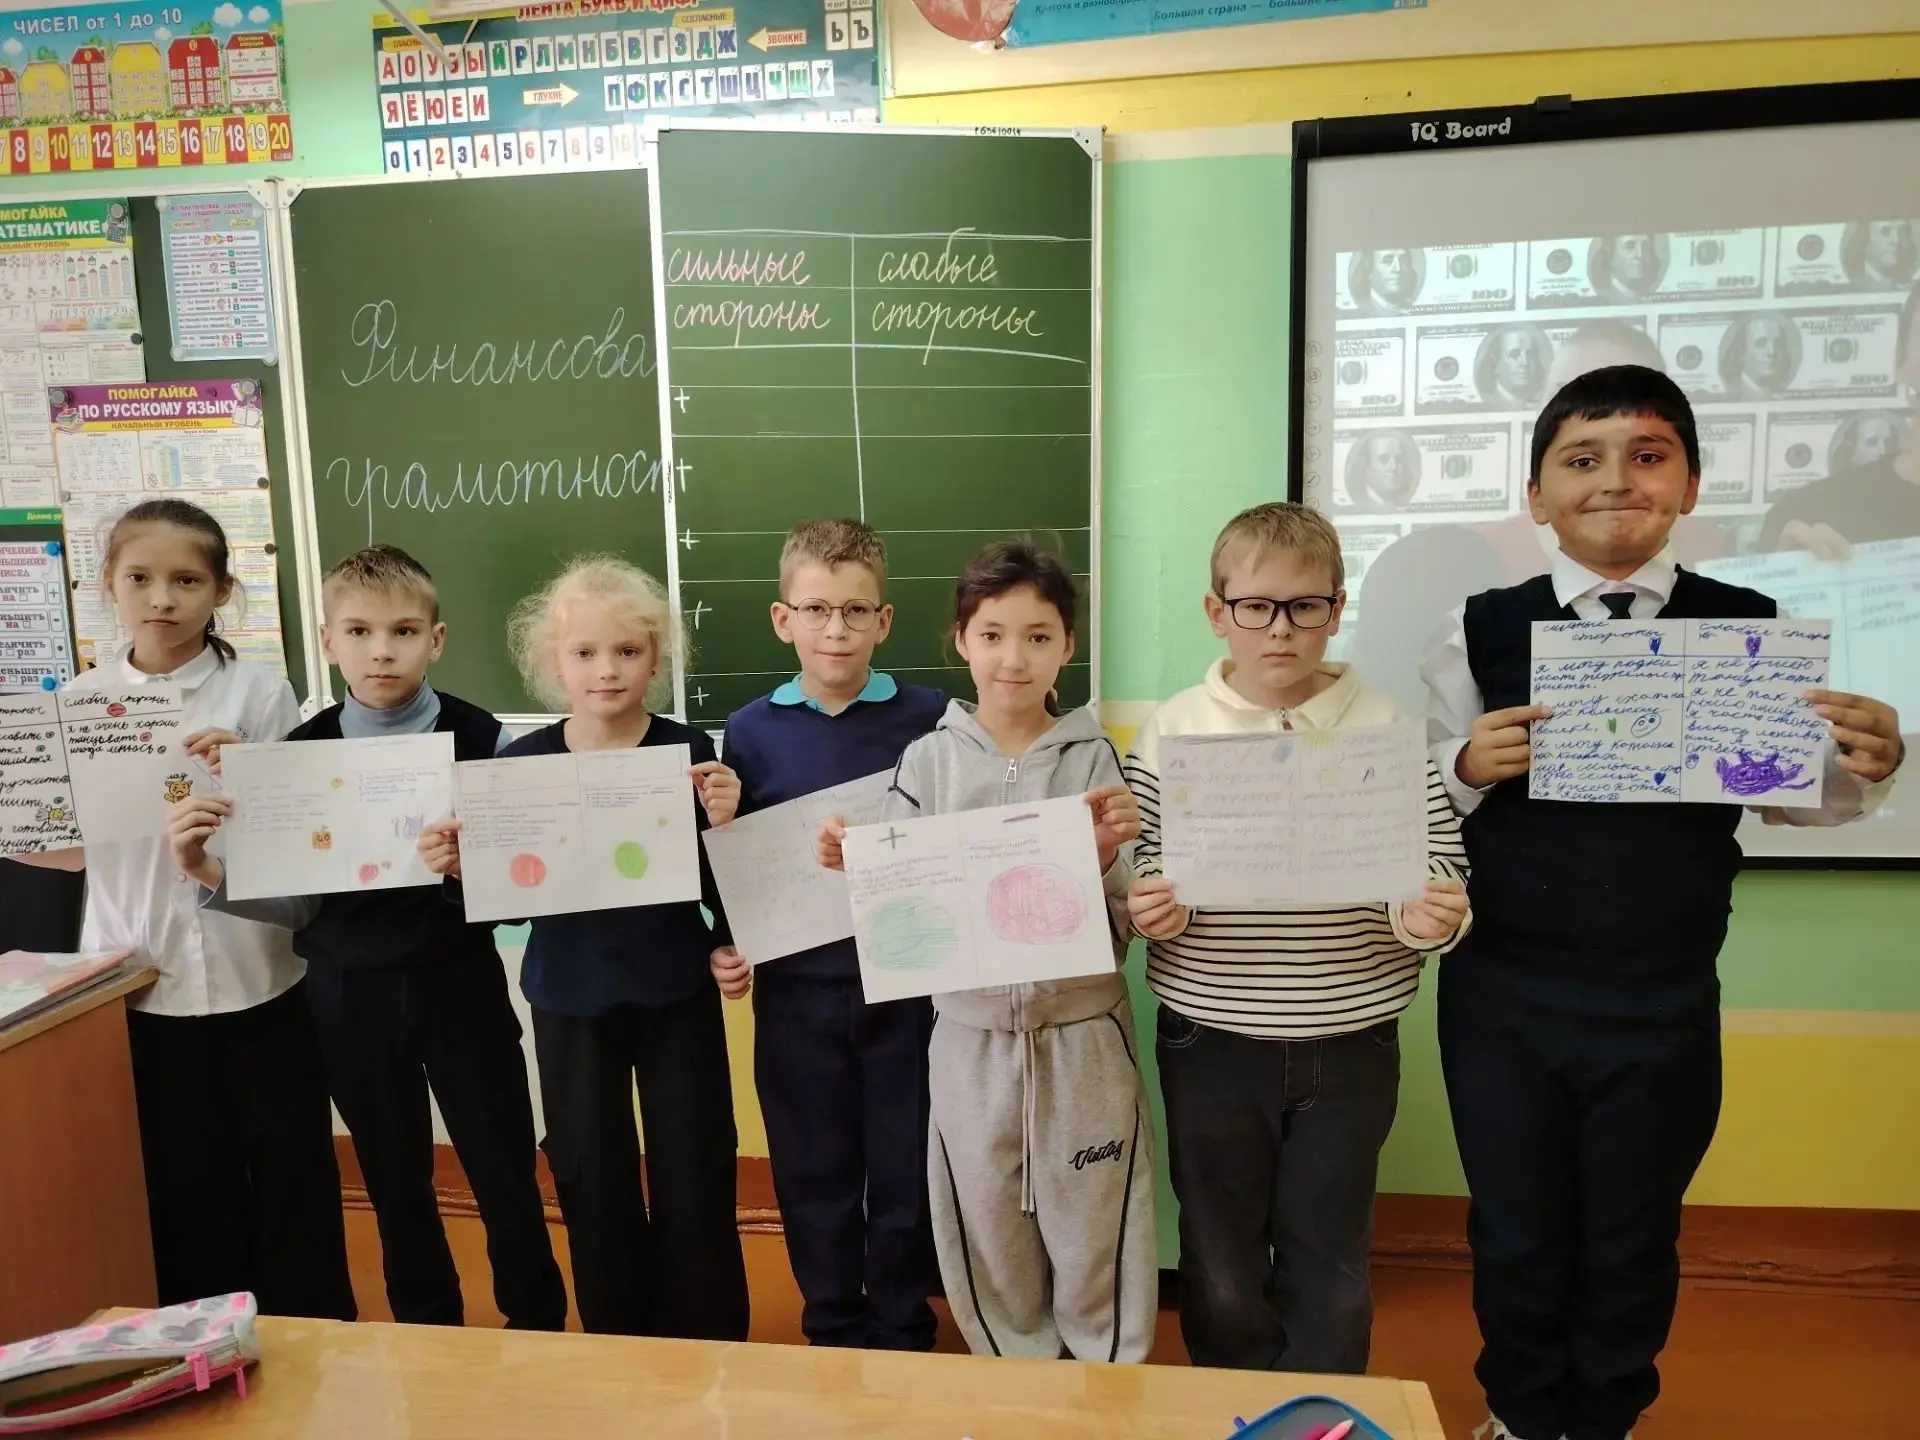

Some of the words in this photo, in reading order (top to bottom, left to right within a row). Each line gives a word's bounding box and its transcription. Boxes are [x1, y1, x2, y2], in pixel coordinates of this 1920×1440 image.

[14, 16, 79, 35] ЧИСЕЛ
[86, 17, 107, 30] от
[113, 12, 122, 28] 1
[130, 13, 154, 30] до
[161, 8, 183, 24] 10
[1208, 5, 1247, 16] страна
[515, 45, 528, 68] Р
[537, 43, 551, 67] Л
[557, 42, 575, 65] М
[583, 40, 597, 63] Н
[605, 39, 619, 61] Б
[628, 37, 642, 60] В
[653, 35, 665, 58] Г
[674, 33, 687, 56] З
[696, 31, 713, 59] Д
[717, 30, 736, 53] Ж
[767, 32, 804, 44] ЗВОНКИЕ
[383, 57, 395, 78] А
[405, 55, 416, 77] О
[427, 53, 438, 76] У
[466, 50, 485, 72] Ы
[533, 90, 563, 102] ГЛУХИЕ
[607, 83, 621, 106] П
[627, 81, 646, 104] Ф
[654, 80, 667, 102] К
[700, 76, 714, 99] Т
[720, 74, 738, 97] Ш
[745, 72, 761, 99] Ц
[386, 100, 399, 122] Я
[406, 94, 418, 121] Ё
[426, 98, 444, 120] Ю
[451, 96, 463, 117] Е
[472, 94, 485, 116] И
[1446, 117, 1512, 140] Board
[14, 136, 26, 163] 8
[33, 134, 46, 162] 9
[50, 133, 69, 160] 10
[72, 132, 89, 160] 11
[92, 131, 112, 159] 12
[114, 129, 134, 157] 13
[136, 129, 156, 156] 14
[158, 127, 178, 155] 15
[180, 126, 200, 153] 16
[203, 126, 221, 154] 17
[226, 124, 246, 152] 18
[248, 122, 268, 152] 19
[270, 122, 289, 150] 20
[391, 151, 400, 168] 0
[414, 149, 420, 166] 1
[435, 147, 444, 164] 2
[458, 146, 467, 163] 3
[480, 144, 489, 161] 4
[503, 142, 512, 159] 5
[525, 141, 534, 159] 6
[548, 139, 557, 157] 7
[594, 136, 604, 154] 9
[668, 248, 811, 285] сильные
[878, 227, 998, 284] слабые
[674, 300, 830, 347] стороны
[872, 302, 1043, 365] стороны
[108, 385, 198, 400] ПОМОГАЙКА
[79, 404, 100, 418] ПО
[104, 402, 181, 418] РУССКОМУ
[186, 400, 237, 415] ЯЗЫКУ
[111, 421, 162, 429] НАЧАЛЬНЫЙ
[165, 420, 203, 428] УРОВЕНЬ
[17, 649, 36, 659] раз
[20, 675, 39, 686] раз
